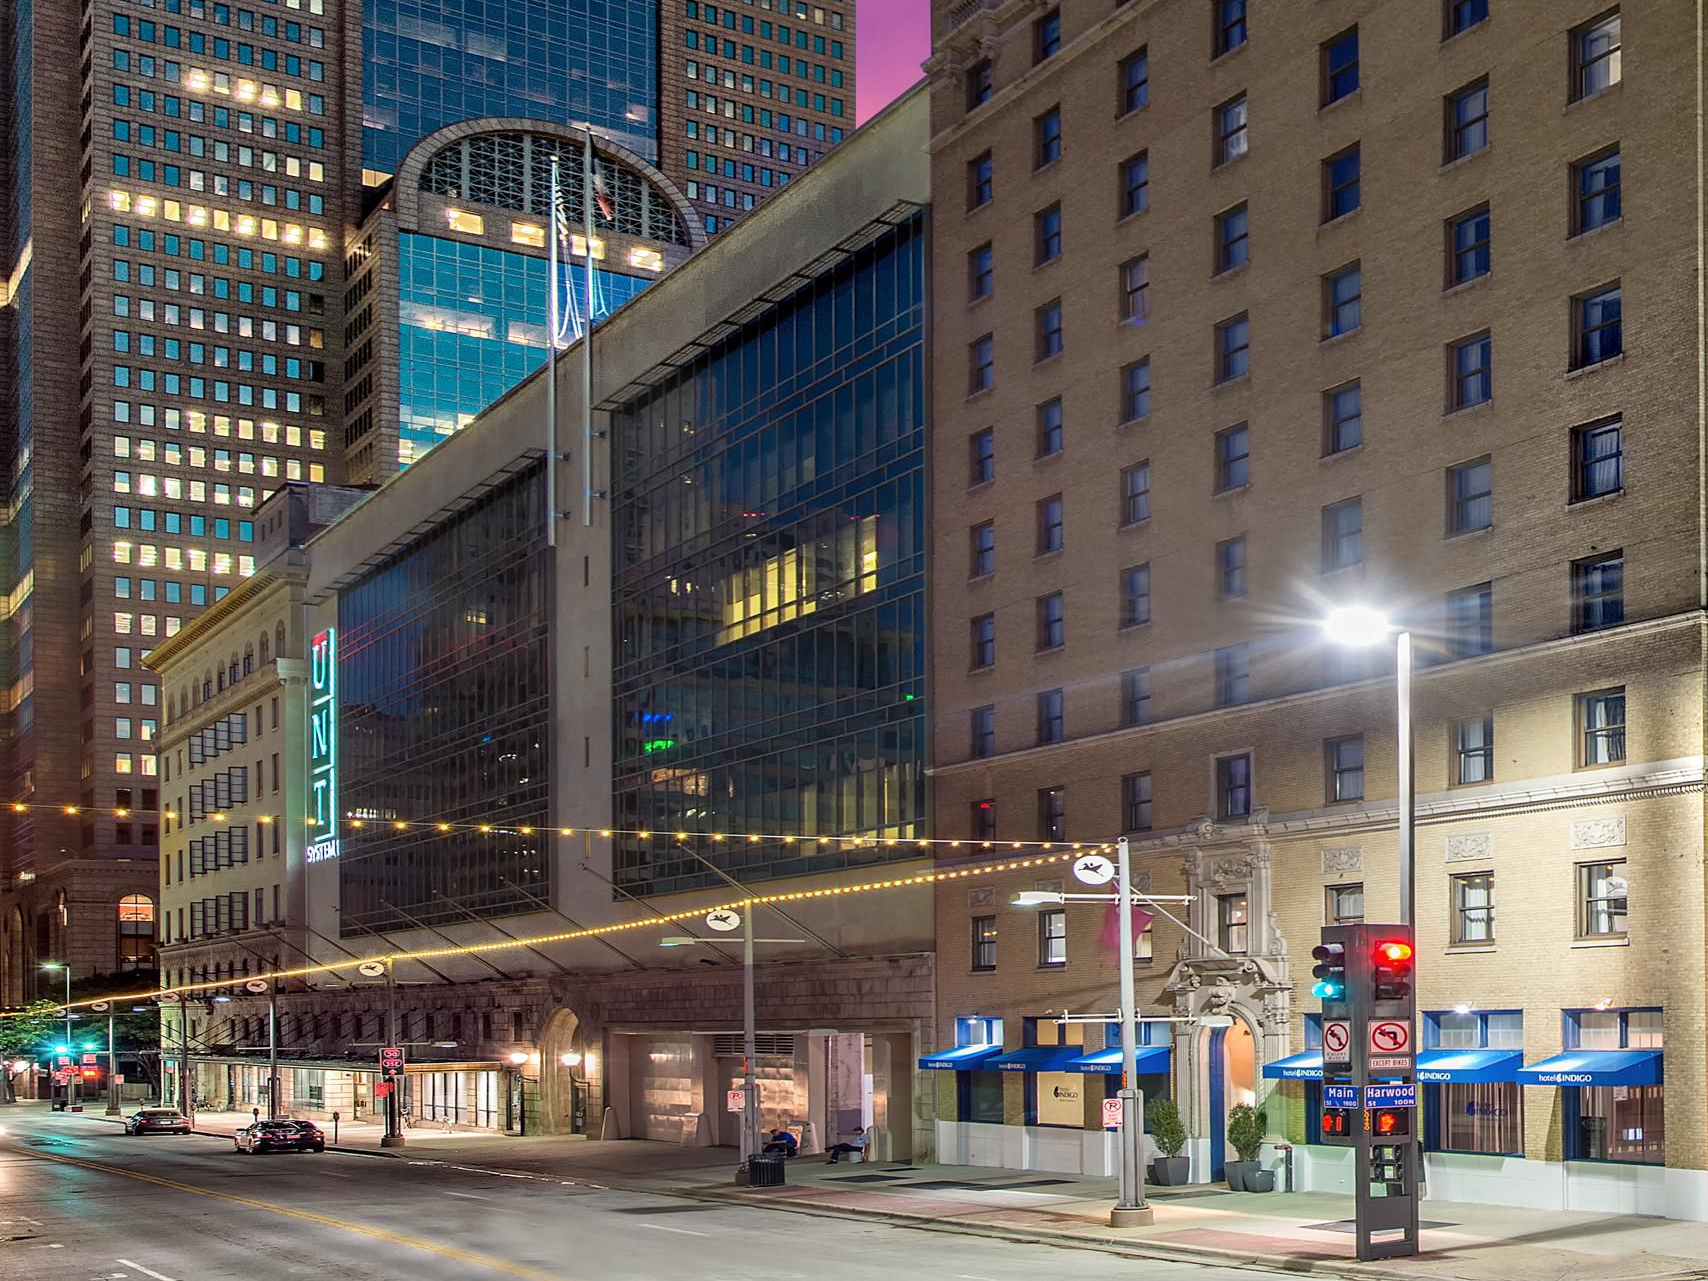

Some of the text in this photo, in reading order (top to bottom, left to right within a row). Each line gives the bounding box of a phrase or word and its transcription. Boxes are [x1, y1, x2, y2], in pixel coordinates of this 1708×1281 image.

[1425, 1072, 1451, 1080] INDIGO
[1328, 1087, 1353, 1098] Main
[1367, 1086, 1414, 1098] Harwood
